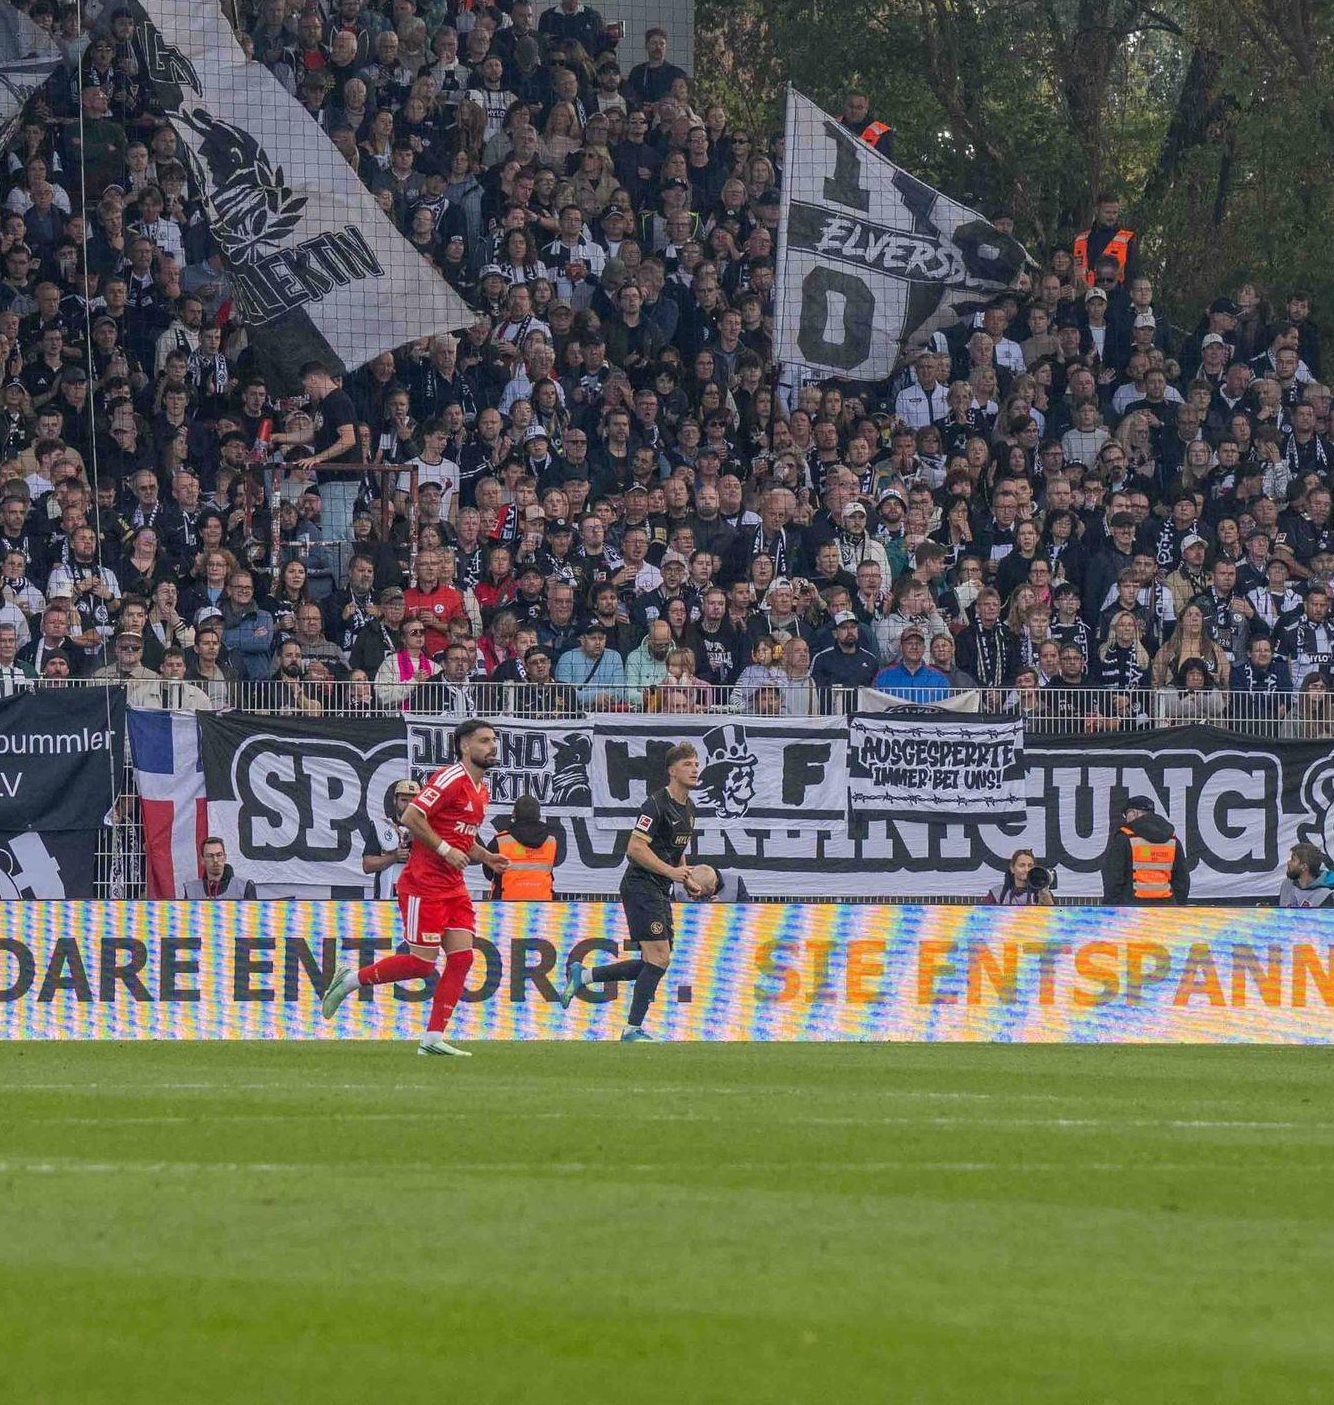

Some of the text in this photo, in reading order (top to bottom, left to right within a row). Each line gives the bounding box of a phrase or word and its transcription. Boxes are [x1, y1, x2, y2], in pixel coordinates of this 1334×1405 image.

[861, 737, 1016, 768] AUSGESPERRTE
[874, 766, 928, 788] IMMER
[964, 769, 1002, 790] UNS!
[754, 940, 886, 1004] SIE
